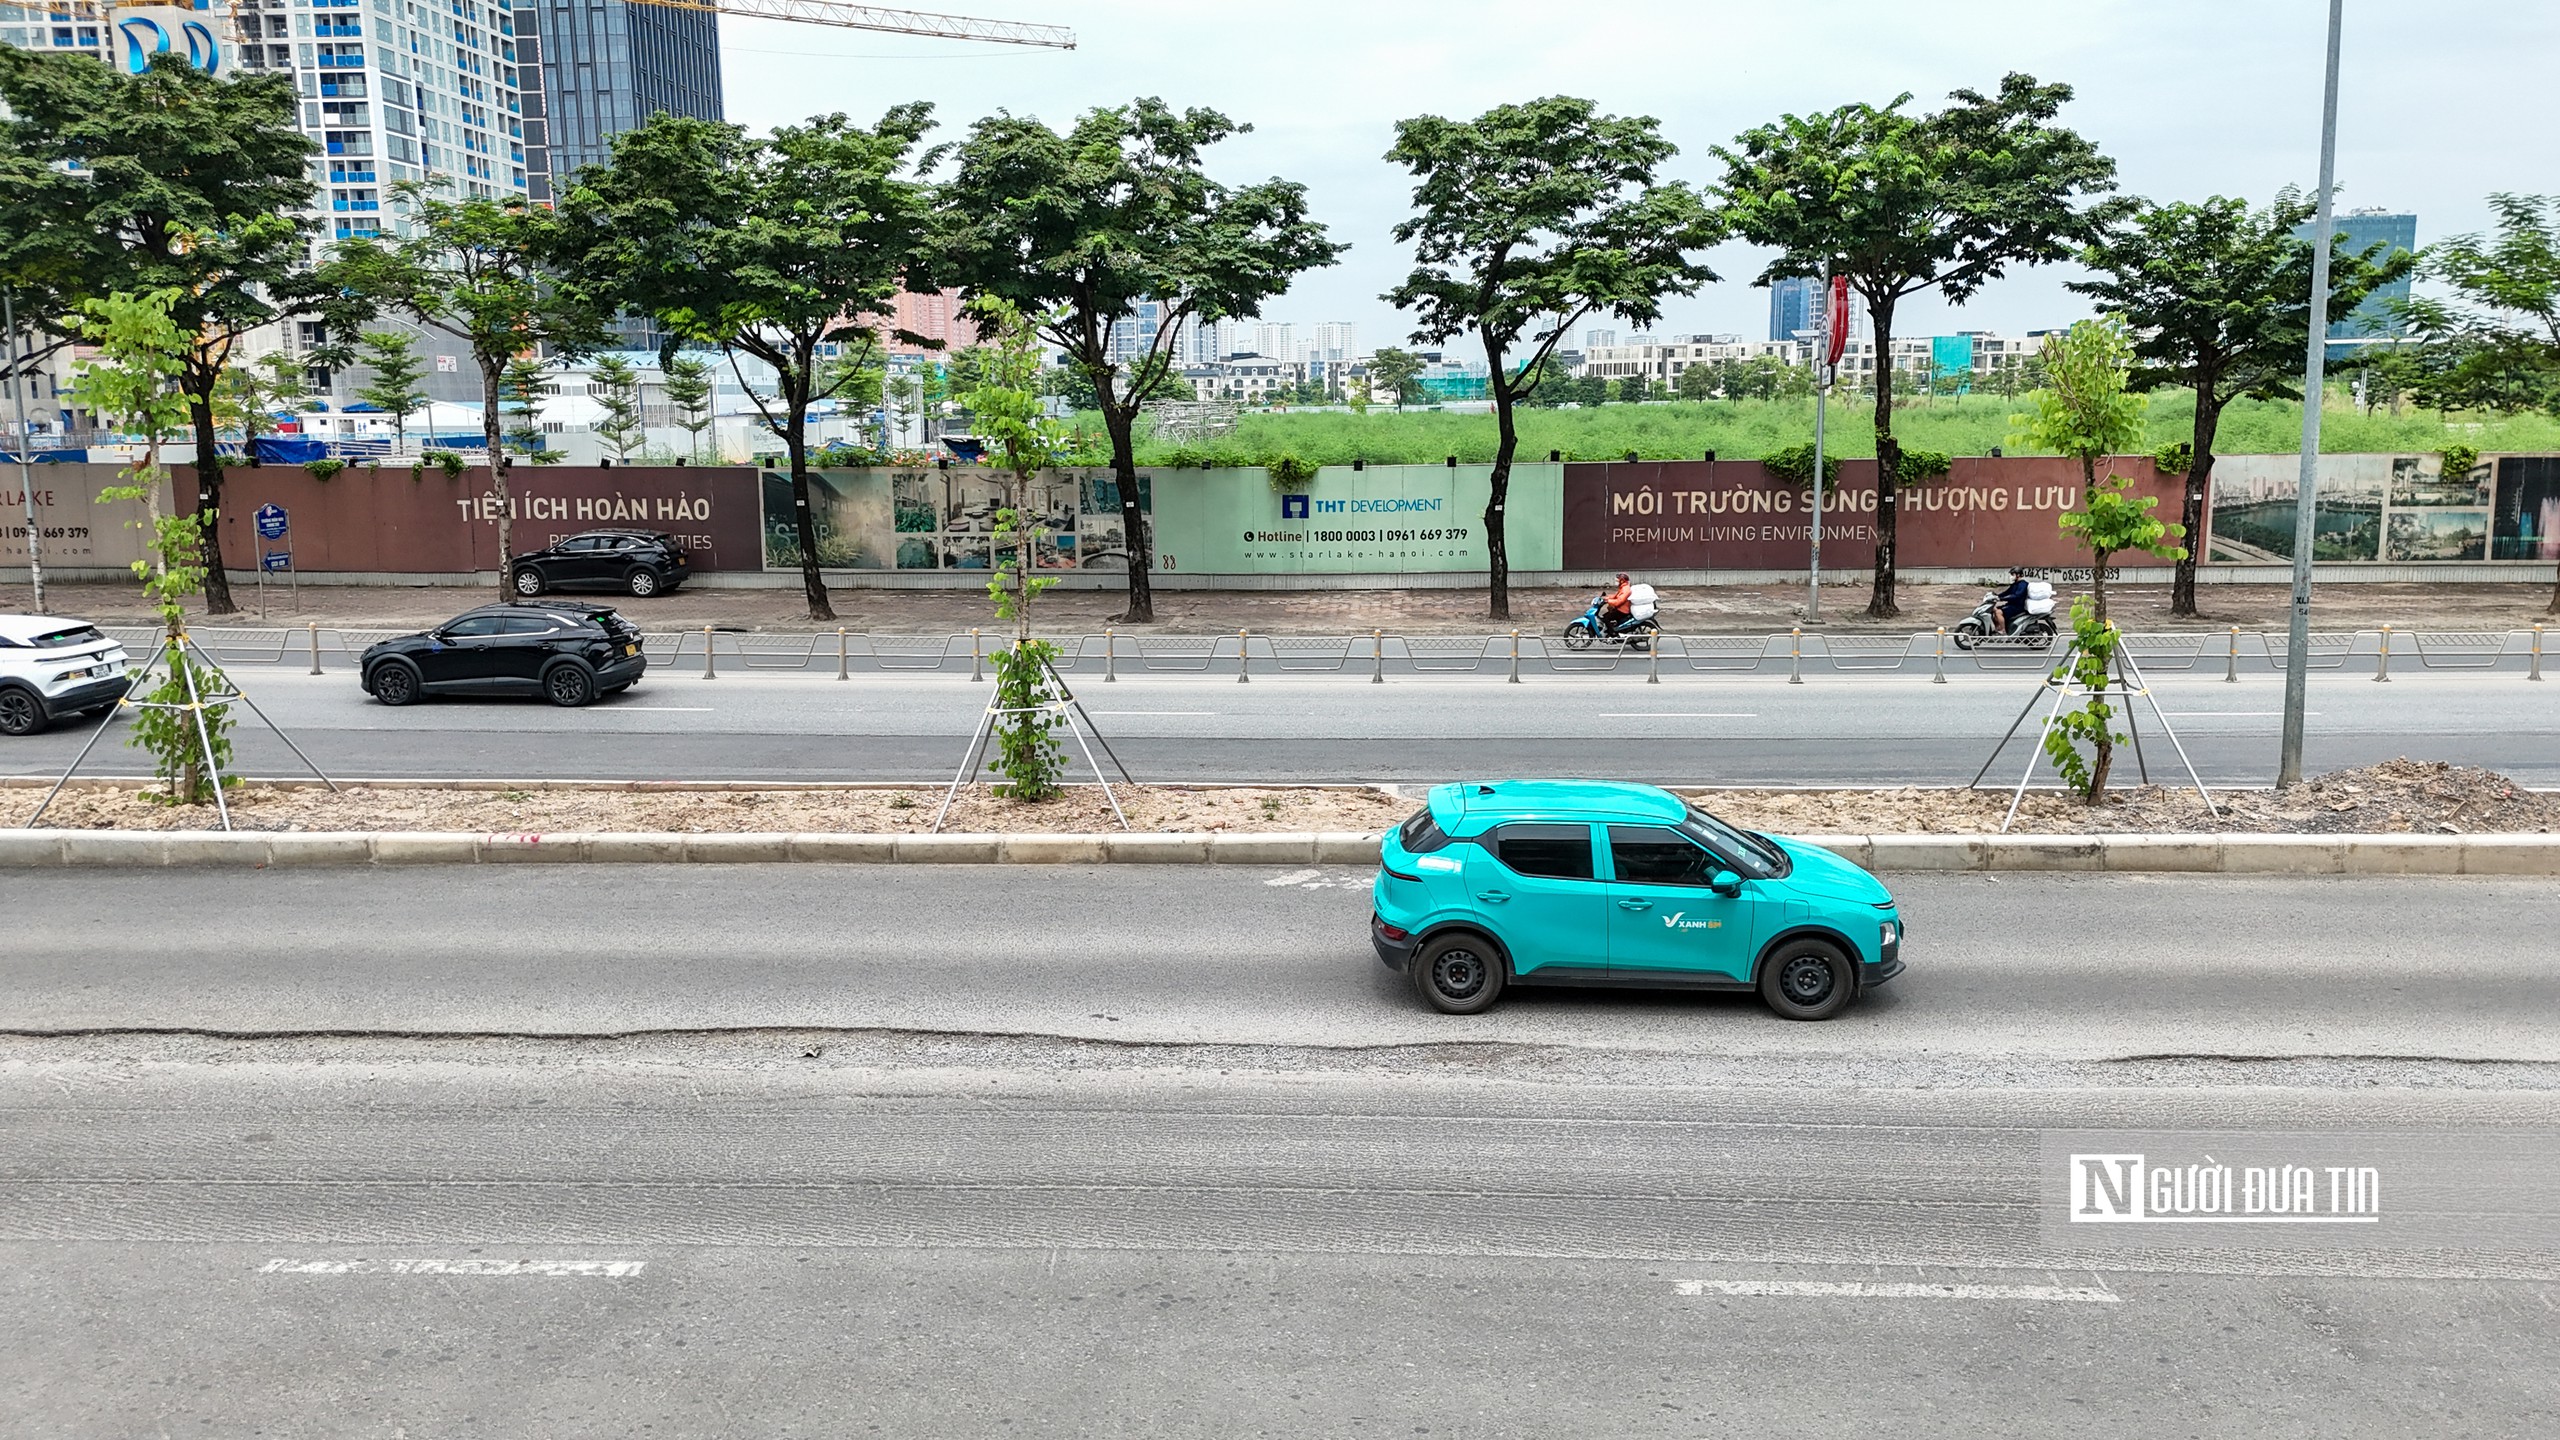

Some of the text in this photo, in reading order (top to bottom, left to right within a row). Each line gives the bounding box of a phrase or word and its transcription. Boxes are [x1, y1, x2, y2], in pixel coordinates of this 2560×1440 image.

[525, 490, 568, 520] ÍCH
[576, 491, 648, 521] HOÀN
[656, 491, 710, 521] HẢO
[1315, 498, 1442, 513] THT DEVELOPMENT
[1613, 484, 1663, 516] MÔI
[1672, 483, 1792, 515] TRƯỜNG
[2016, 485, 2076, 511] LƯU
[12, 527, 40, 538] 091
[44, 527, 65, 538] 669
[67, 527, 89, 538] 379
[1258, 530, 1302, 542] Hotline
[1314, 530, 1343, 542] 1800
[1346, 530, 1376, 542] 0003
[1386, 529, 1415, 541] 0961
[1419, 529, 1442, 541] 669
[1445, 528, 1468, 540] 379
[1612, 525, 1878, 543] PREMIUM LIVING ENVIRNMEN
[1244, 549, 1468, 559] www.starlake-hanoi.com
[1678, 920, 1707, 928] XANH
